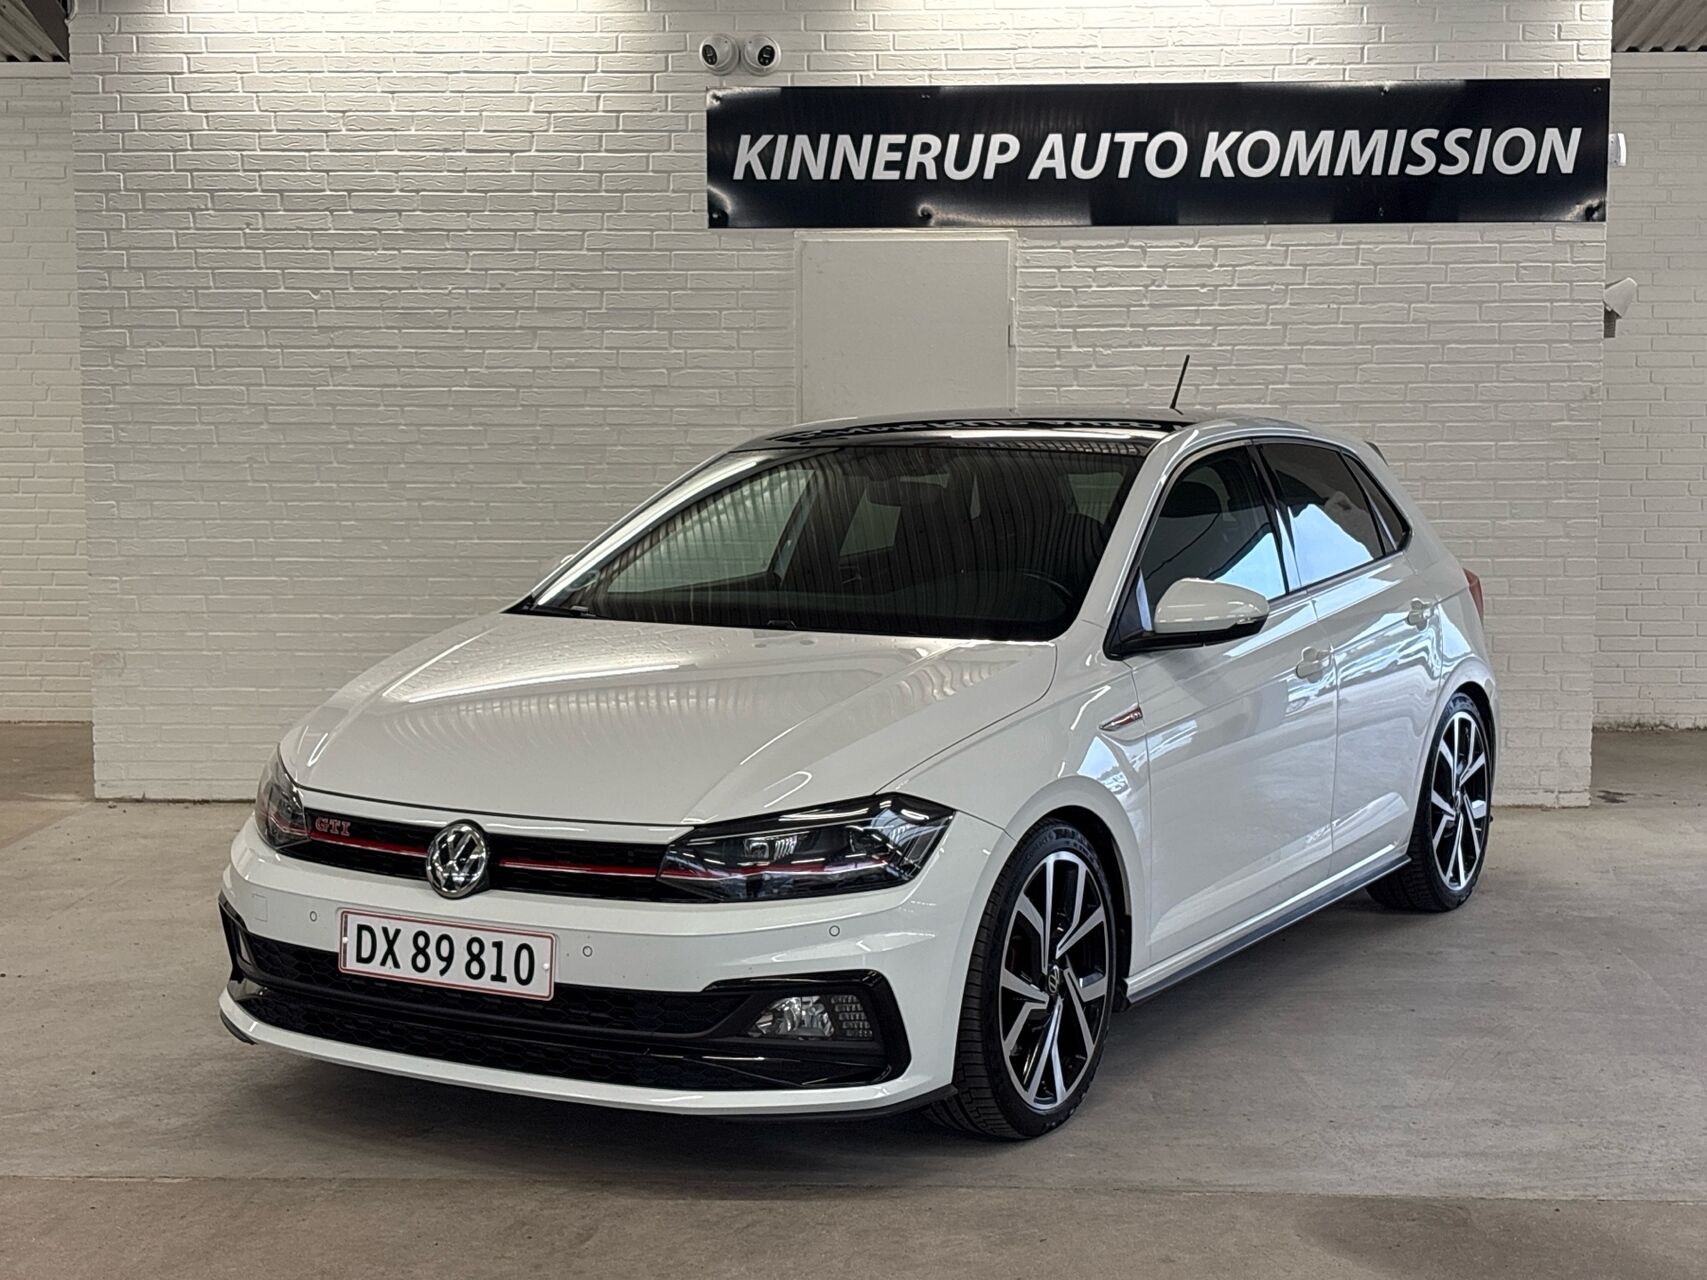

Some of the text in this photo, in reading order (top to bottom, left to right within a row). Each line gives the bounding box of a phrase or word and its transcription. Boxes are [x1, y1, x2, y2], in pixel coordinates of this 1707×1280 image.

[732, 127, 1583, 180] KINNERUP AUTO KOMMISSION
[315, 816, 352, 837] GTI
[355, 923, 536, 987] DX 89 810
